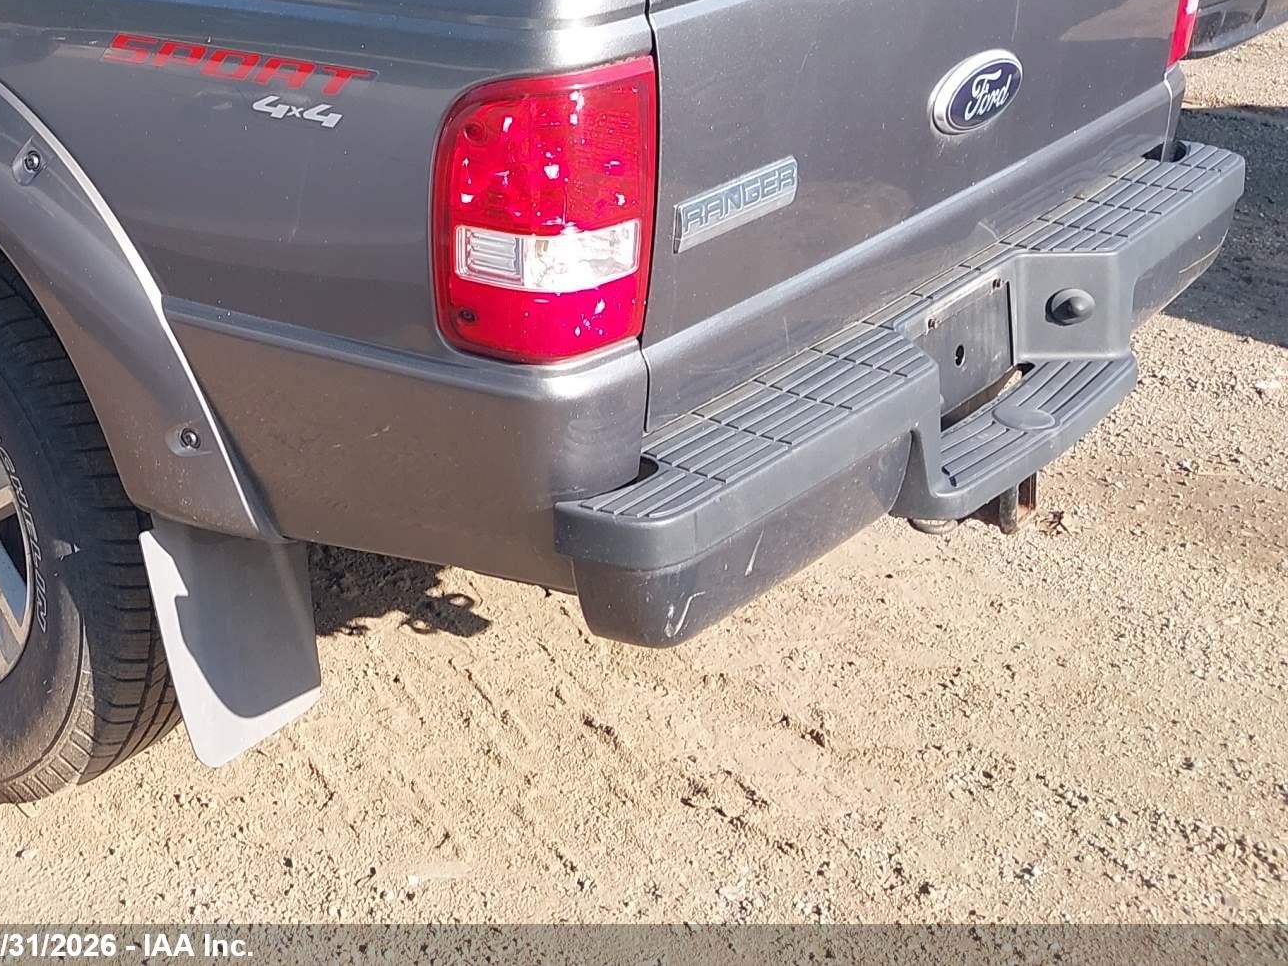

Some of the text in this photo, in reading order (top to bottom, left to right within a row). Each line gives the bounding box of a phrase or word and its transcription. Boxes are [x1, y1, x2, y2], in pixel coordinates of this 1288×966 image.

[103, 32, 370, 96] SPORT
[252, 95, 344, 129] 4x4
[964, 68, 1013, 122] Ford
[682, 161, 797, 234] RANGER
